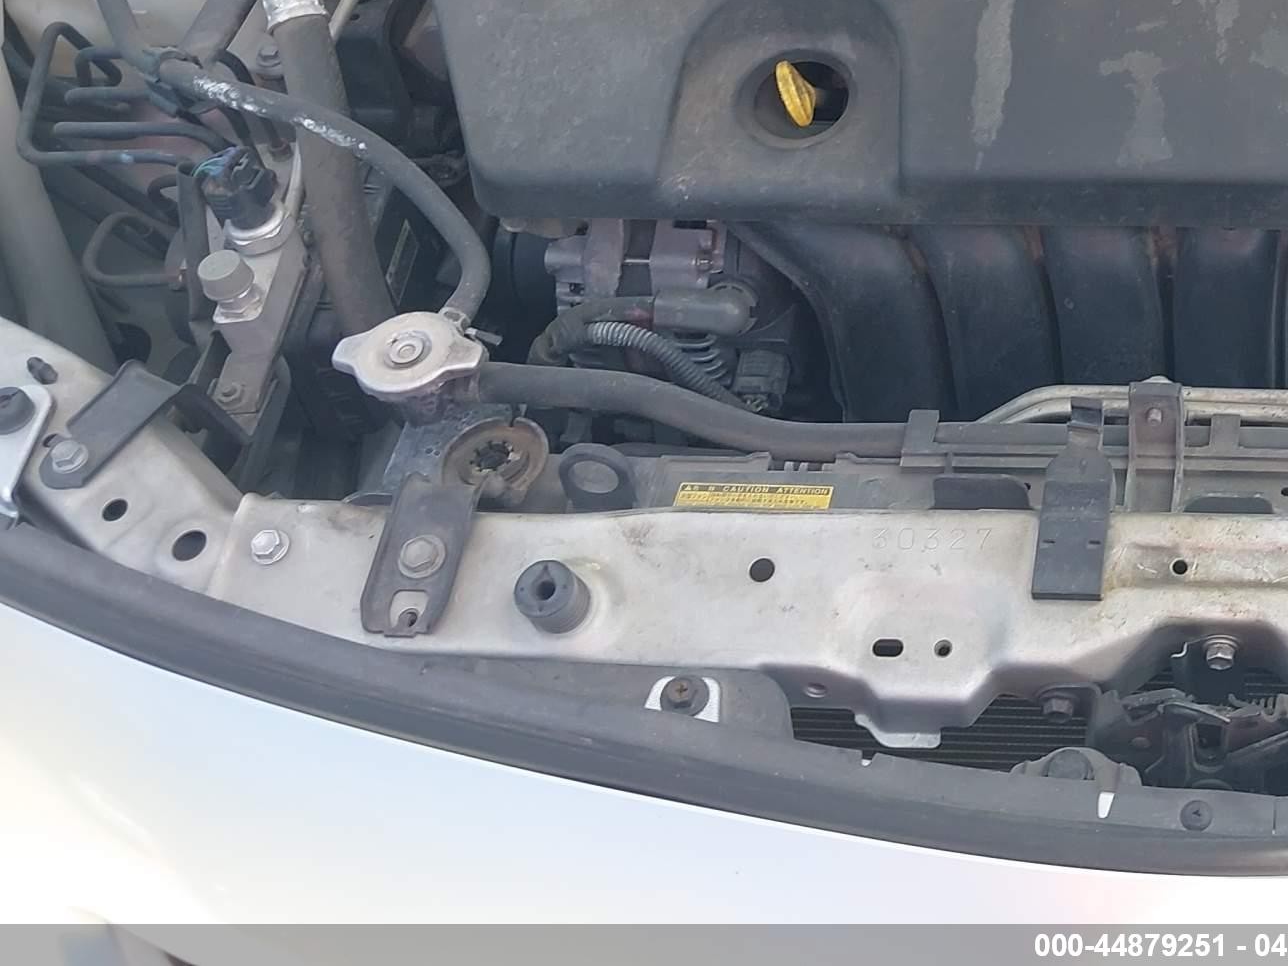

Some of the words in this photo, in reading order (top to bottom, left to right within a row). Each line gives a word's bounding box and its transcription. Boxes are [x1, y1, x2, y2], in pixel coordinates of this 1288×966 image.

[723, 485, 769, 493] CAUTION
[777, 486, 828, 495] ATTENTION
[872, 527, 992, 550] 30327
